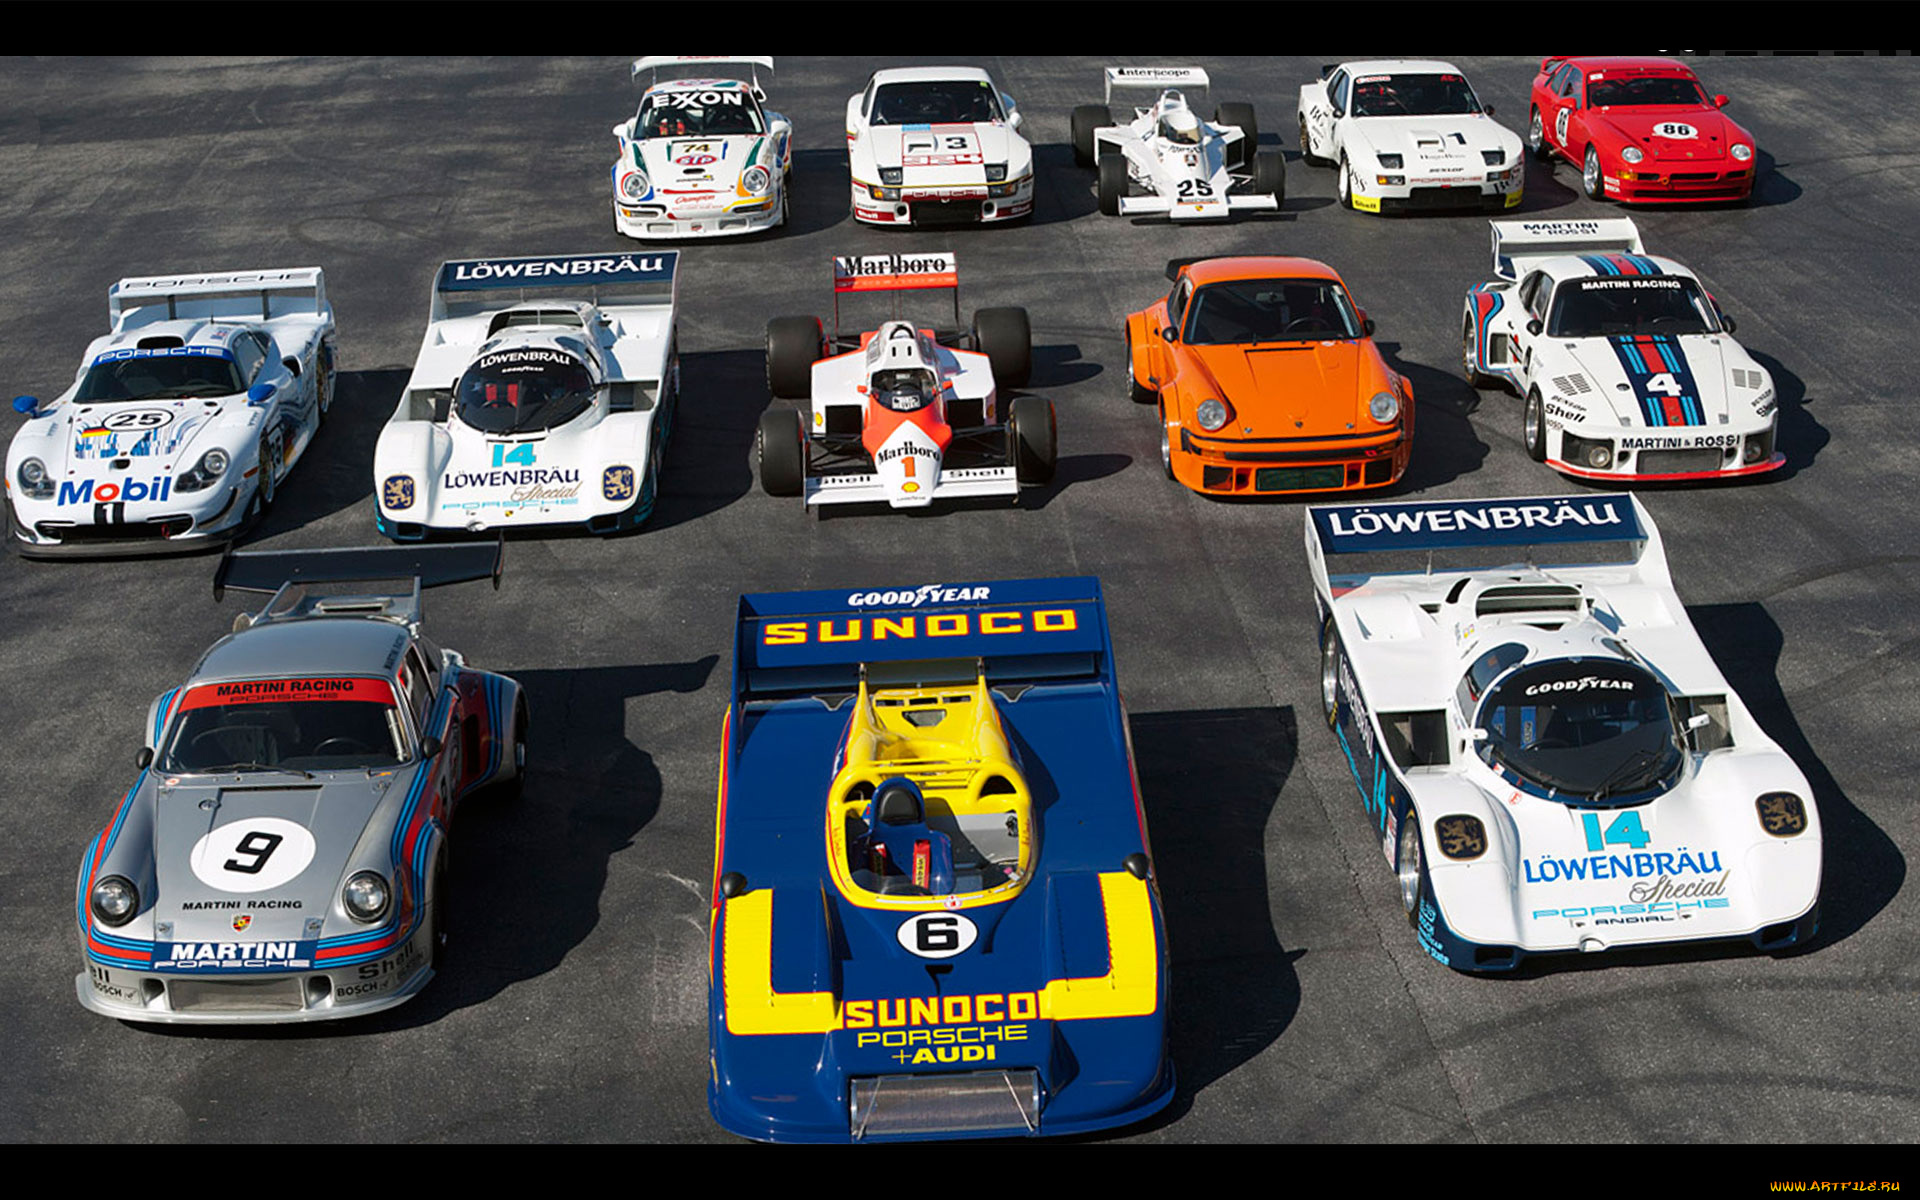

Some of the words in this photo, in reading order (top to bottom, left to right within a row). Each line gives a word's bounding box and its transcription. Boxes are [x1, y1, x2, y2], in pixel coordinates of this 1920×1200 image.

[652, 92, 743, 109] EXXON
[1664, 124, 1690, 135] 86
[684, 143, 710, 153] 74
[945, 136, 967, 149] 3
[1177, 178, 1214, 197] 25
[1523, 222, 1599, 230] MARTINI
[1548, 228, 1597, 236] ROSSI
[455, 256, 664, 281] LÖWENBRÄU
[844, 254, 947, 277] Marlboro
[125, 273, 314, 289] PORSCHE
[1582, 280, 1631, 290] MARTINI
[1632, 280, 1682, 290] RACING
[98, 346, 224, 362] PORSCHE
[1646, 372, 1683, 397] 4
[114, 410, 164, 427] 25
[1545, 402, 1586, 423] Shell
[877, 441, 941, 464] Marlboro
[1621, 437, 1682, 448] MARTINI
[491, 443, 537, 468] 14
[901, 456, 916, 477] 1
[949, 468, 1006, 478] Shell
[444, 466, 580, 489] LÖWENBRÄU
[816, 474, 871, 484] Shell
[57, 476, 172, 506] Mobil
[510, 480, 584, 502] Special
[101, 503, 114, 524] 1
[442, 498, 579, 510] PORSCHE
[1329, 500, 1622, 537] LÖWENBRÄU
[848, 584, 991, 607] GOODYEAR
[763, 609, 1078, 645] SUNOCO
[217, 681, 285, 697] MARTINI
[290, 680, 354, 691] RACING
[1525, 675, 1635, 697] GOODYEAR
[230, 692, 339, 703] PORSCHE
[1581, 811, 1651, 852] 14
[223, 831, 284, 875] 9
[1523, 847, 1723, 884] LÖWENBRÄU
[1628, 869, 1731, 905] Special
[182, 901, 242, 911] MARTINI
[247, 900, 303, 910] RACING
[1532, 897, 1731, 920] PORSCHE
[1594, 914, 1676, 927] ANDIAL
[915, 917, 960, 952] 6
[171, 942, 296, 960] MARTINI
[358, 940, 413, 980] Shell
[154, 960, 310, 970] PORSCHE
[337, 981, 378, 997] BOSCH
[845, 992, 1038, 1029] SUNOCO
[857, 1024, 1029, 1048] PORSCHE
